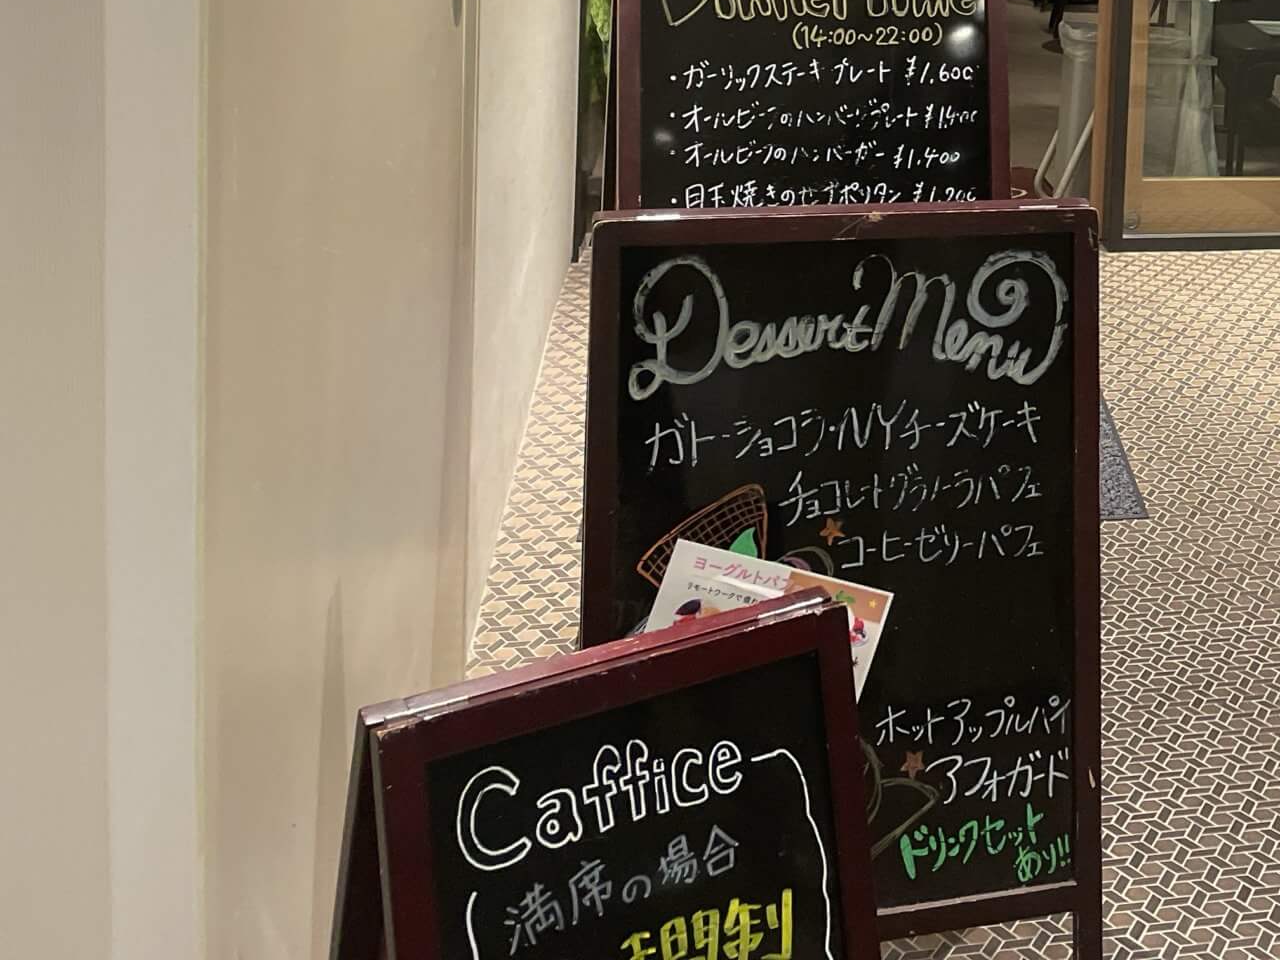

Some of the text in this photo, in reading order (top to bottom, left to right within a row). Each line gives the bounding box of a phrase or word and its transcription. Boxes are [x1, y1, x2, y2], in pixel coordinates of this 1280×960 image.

[628, 249, 1070, 401] Dessert Menu
[875, 696, 1072, 746] ホットアップルパイ
[456, 739, 744, 871] Caffice
[924, 747, 1070, 805] アフォガード
[502, 823, 740, 957] 満席の場合
[900, 802, 1044, 880] ドリンクセット
